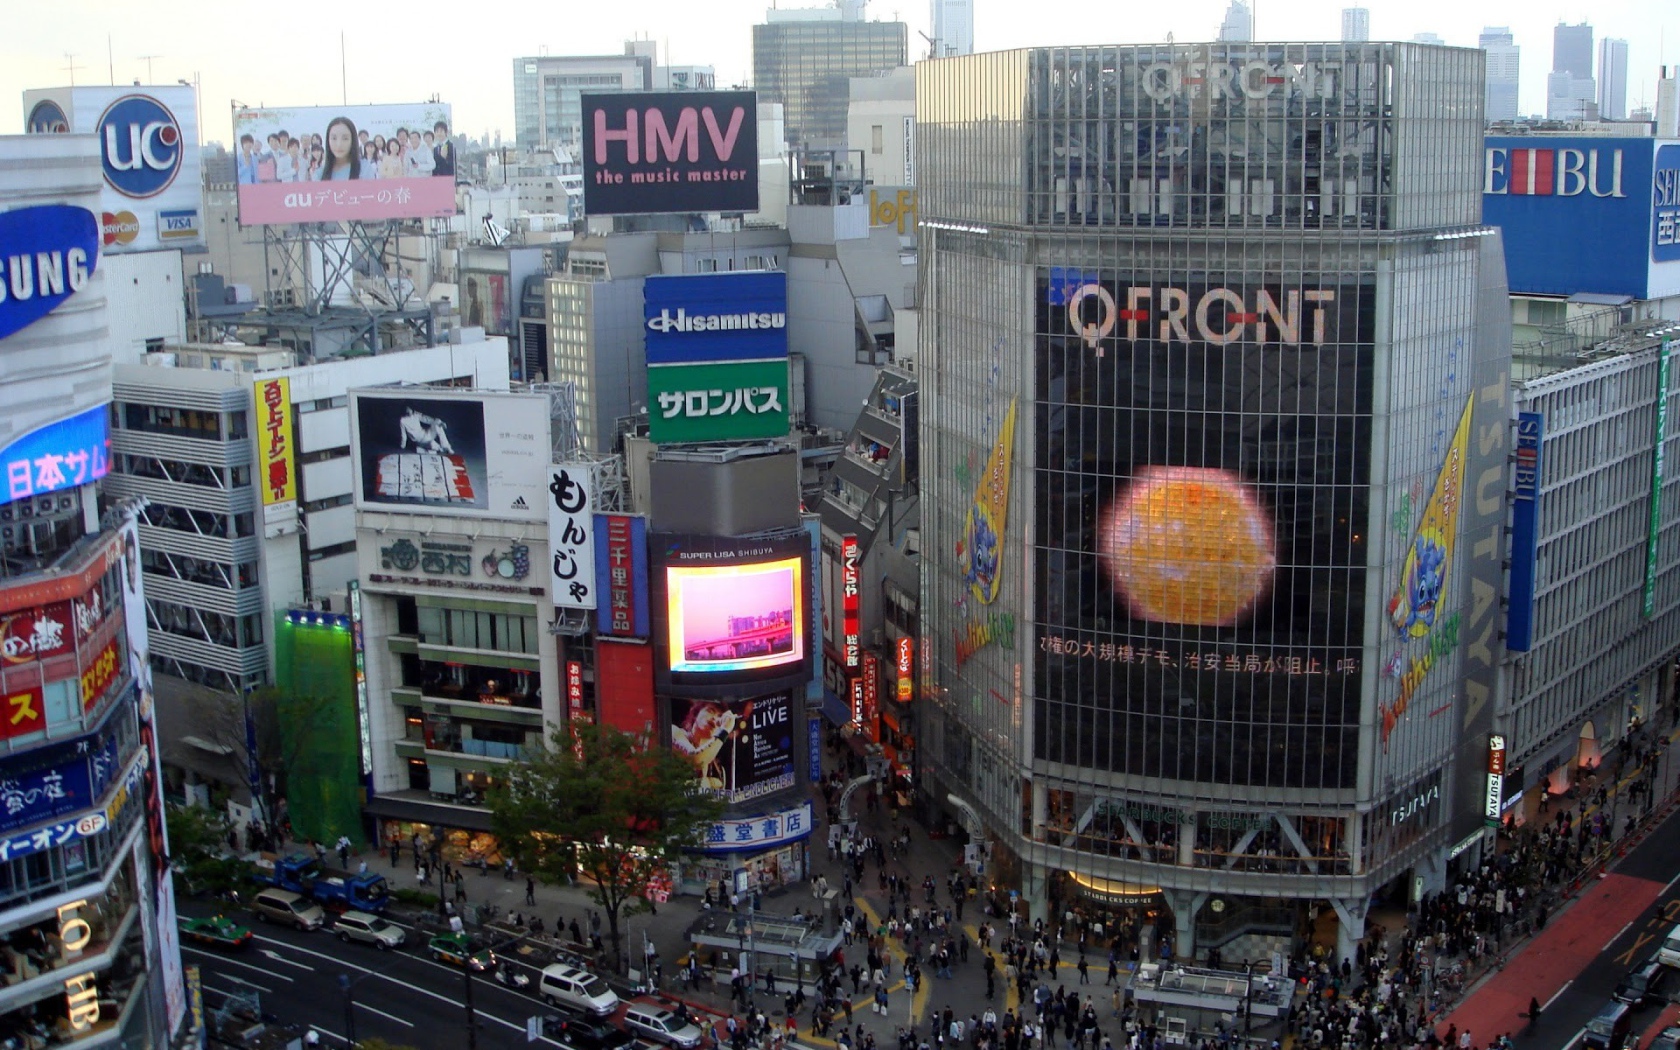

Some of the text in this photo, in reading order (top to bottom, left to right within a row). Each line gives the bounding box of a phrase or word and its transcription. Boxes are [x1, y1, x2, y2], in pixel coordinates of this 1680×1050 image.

[594, 107, 744, 165] HMV
[596, 168, 746, 184] the music master
[1655, 168, 1680, 206] SEI
[284, 187, 411, 208] au デビューの春
[167, 217, 192, 230] VISA
[648, 308, 785, 332] Hisamitsu
[1069, 284, 1334, 357] QFRONT
[658, 387, 781, 418] サロンパス
[1516, 419, 1538, 500] SEIBU
[550, 469, 588, 603] もんじゃ
[738, 547, 773, 557] SHIBUYA
[1464, 372, 1506, 732] TSUTAYA
[609, 522, 630, 631] 三千里薬品
[753, 706, 788, 729] LIVE
[1489, 774, 1499, 818] TSUTAYA
[80, 816, 101, 832] 6F
[690, 813, 801, 842] 盛堂書店
[1098, 803, 1273, 832] STARBUCKS COFFEE
